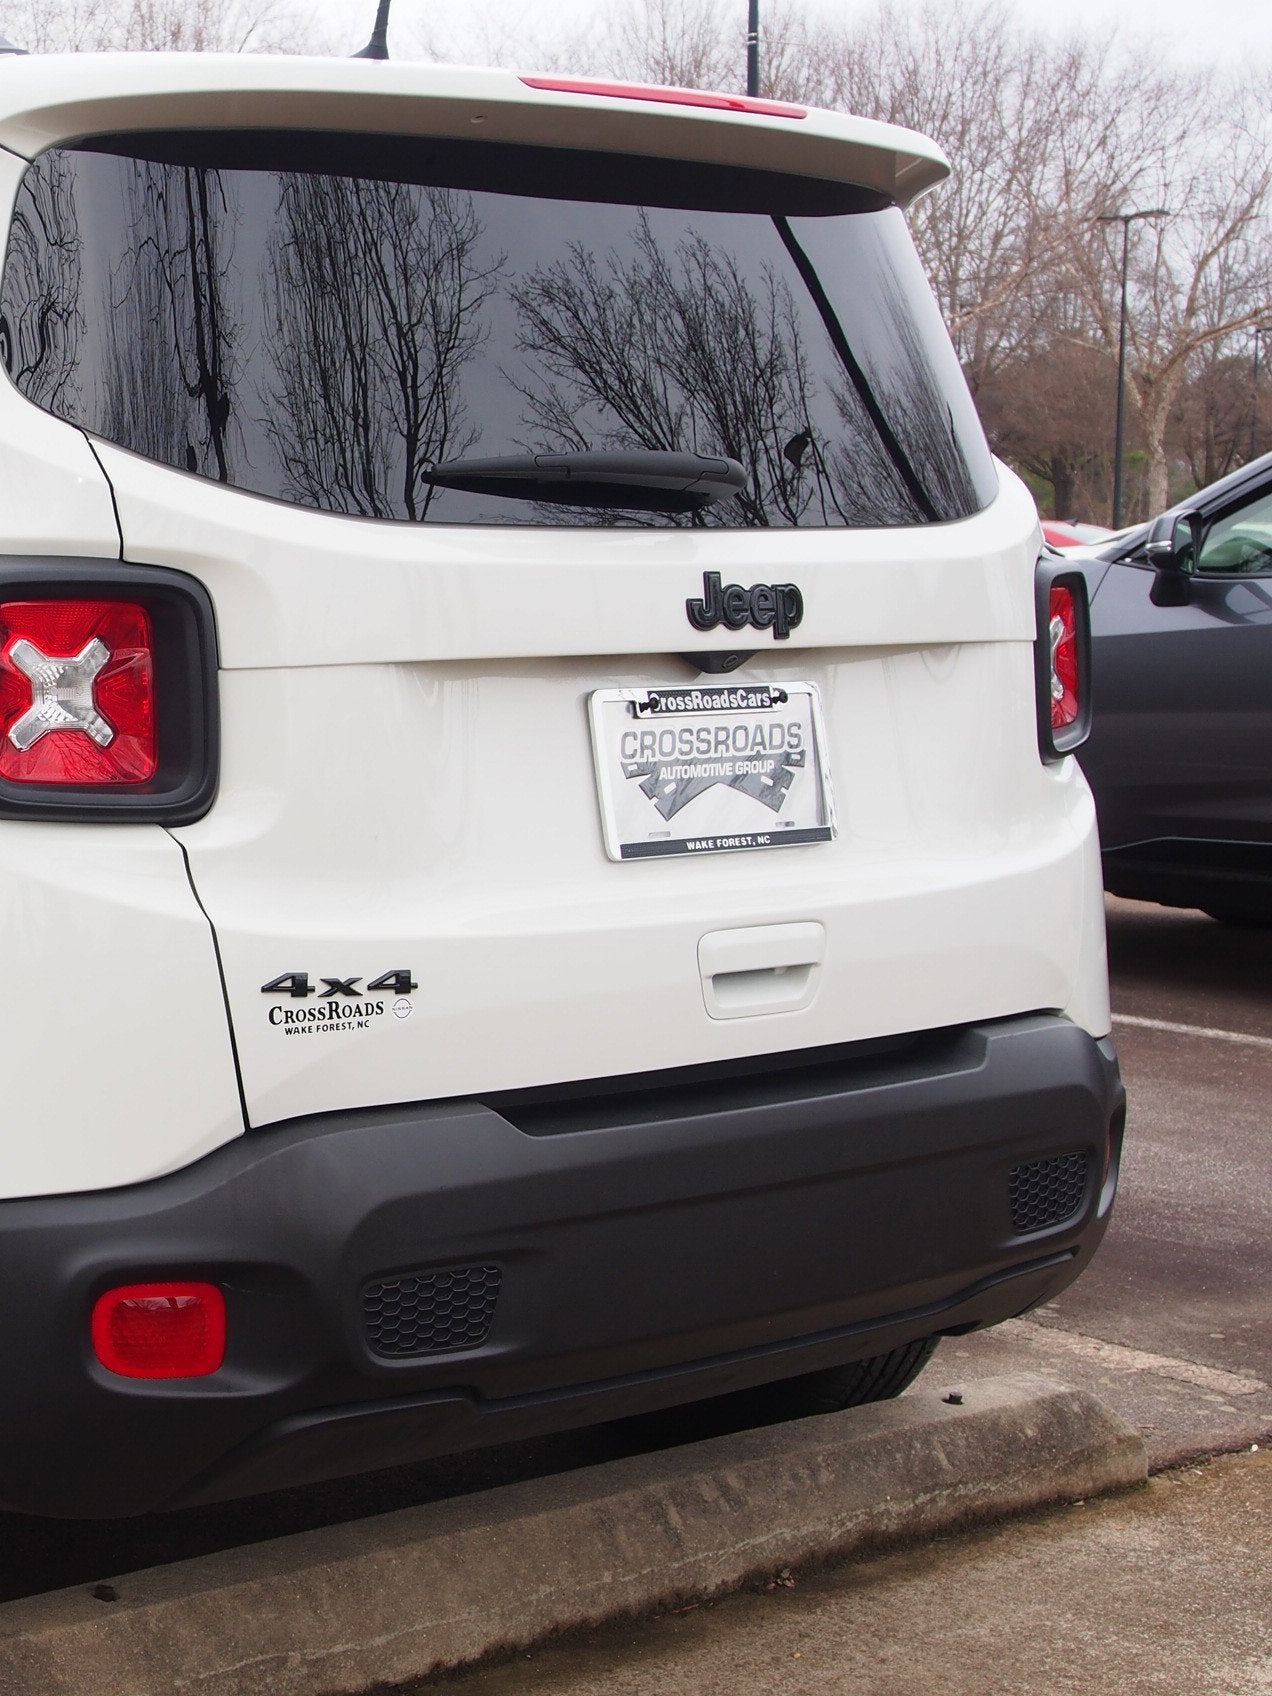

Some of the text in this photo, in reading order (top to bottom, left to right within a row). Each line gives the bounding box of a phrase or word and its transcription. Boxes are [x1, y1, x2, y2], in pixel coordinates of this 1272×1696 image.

[686, 570, 804, 640] Jeep
[620, 722, 803, 760] CROSSROADS
[659, 760, 775, 780] AUTOMOTIVE GROUP
[686, 835, 771, 850] WAKE FOREST, NC
[261, 969, 418, 998] 4x4
[284, 1019, 370, 1036] WAKE FOREST, NC
